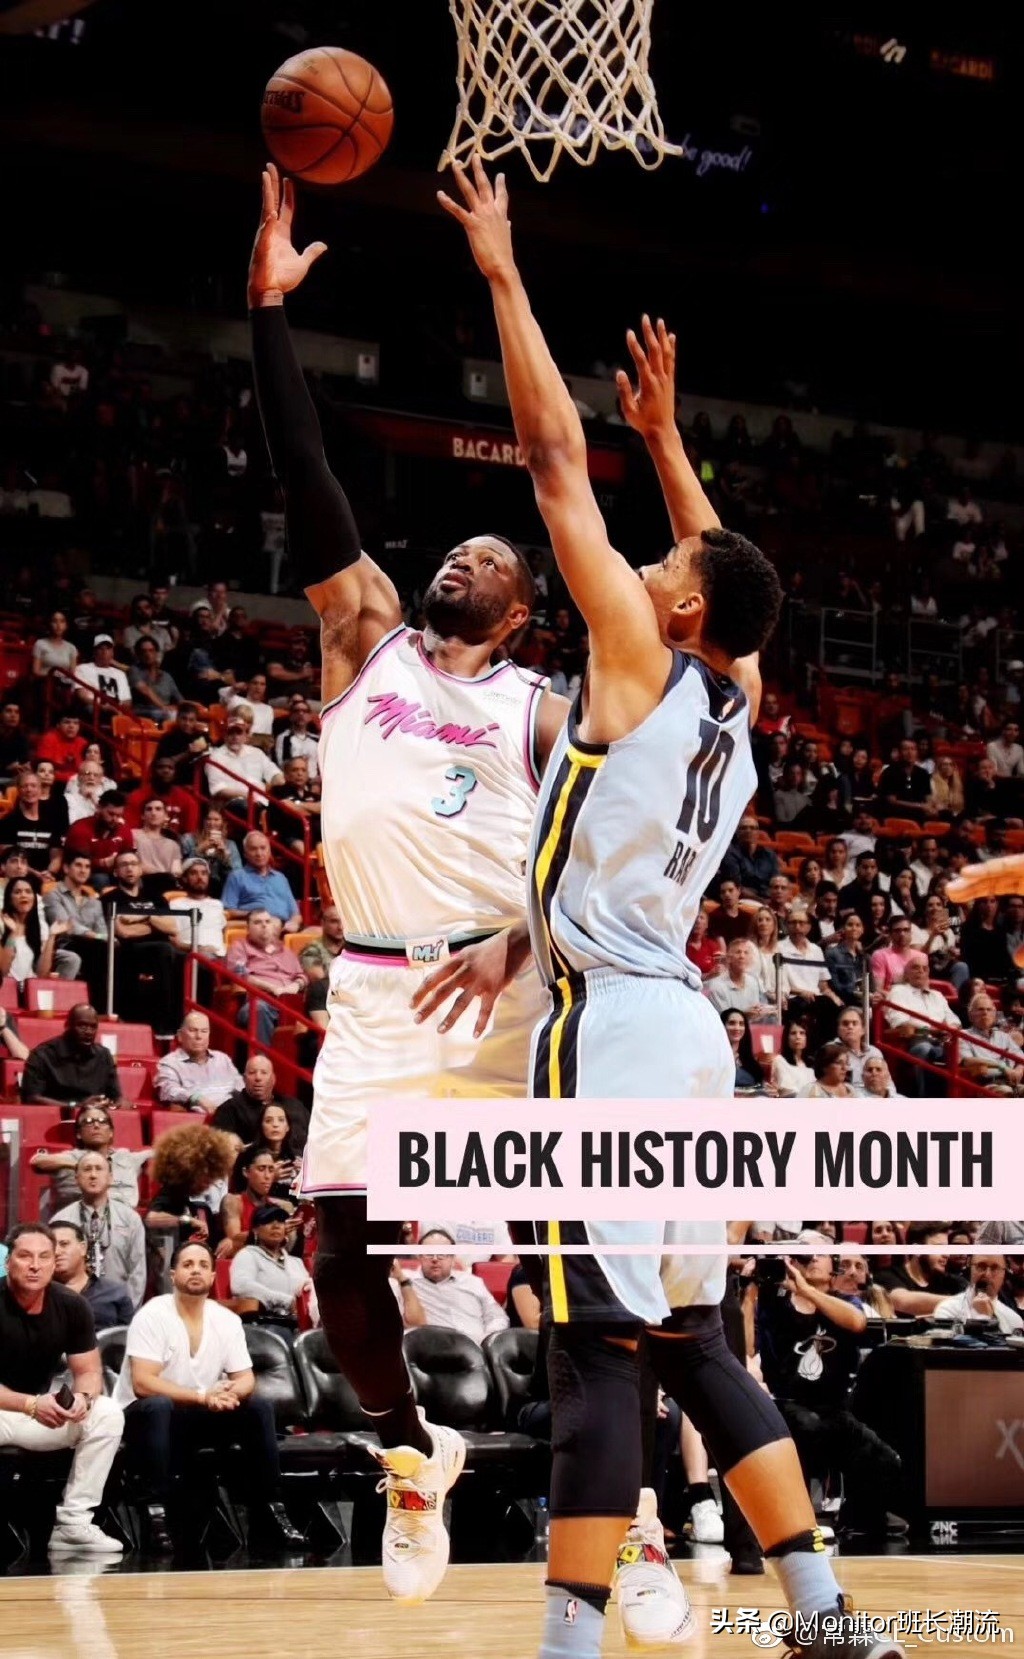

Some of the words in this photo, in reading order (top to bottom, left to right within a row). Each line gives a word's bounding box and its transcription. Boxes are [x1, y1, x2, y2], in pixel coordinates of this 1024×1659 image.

[697, 145, 753, 177] good!
[452, 437, 528, 466] BACARD
[364, 691, 500, 749] Miami
[431, 765, 479, 819] 3
[675, 718, 735, 843] 10
